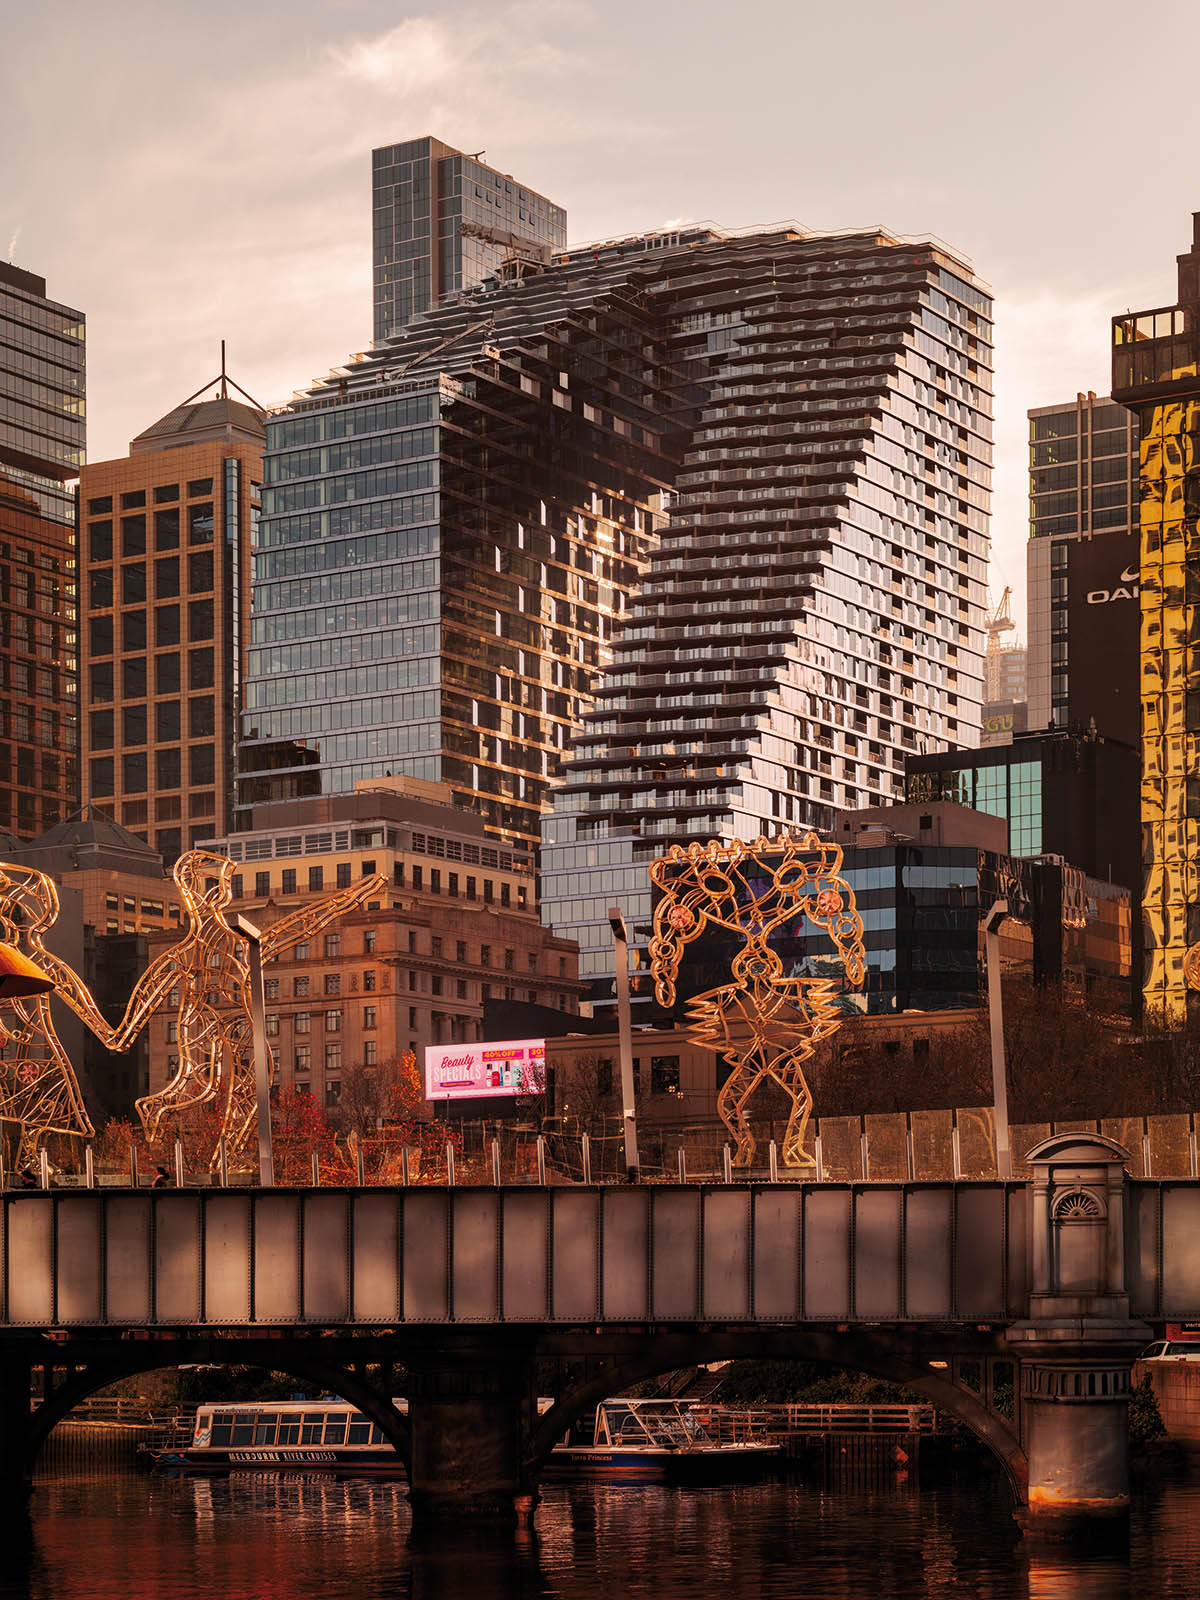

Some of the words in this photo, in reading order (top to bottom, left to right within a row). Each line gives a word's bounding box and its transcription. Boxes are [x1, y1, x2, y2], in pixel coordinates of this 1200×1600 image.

[441, 1054, 474, 1071] Beauty
[433, 1064, 481, 1082] SPECIALS
[228, 1452, 280, 1460] MELBOURNE
[283, 1452, 304, 1460] RIVER
[306, 1452, 337, 1460] CRUISES
